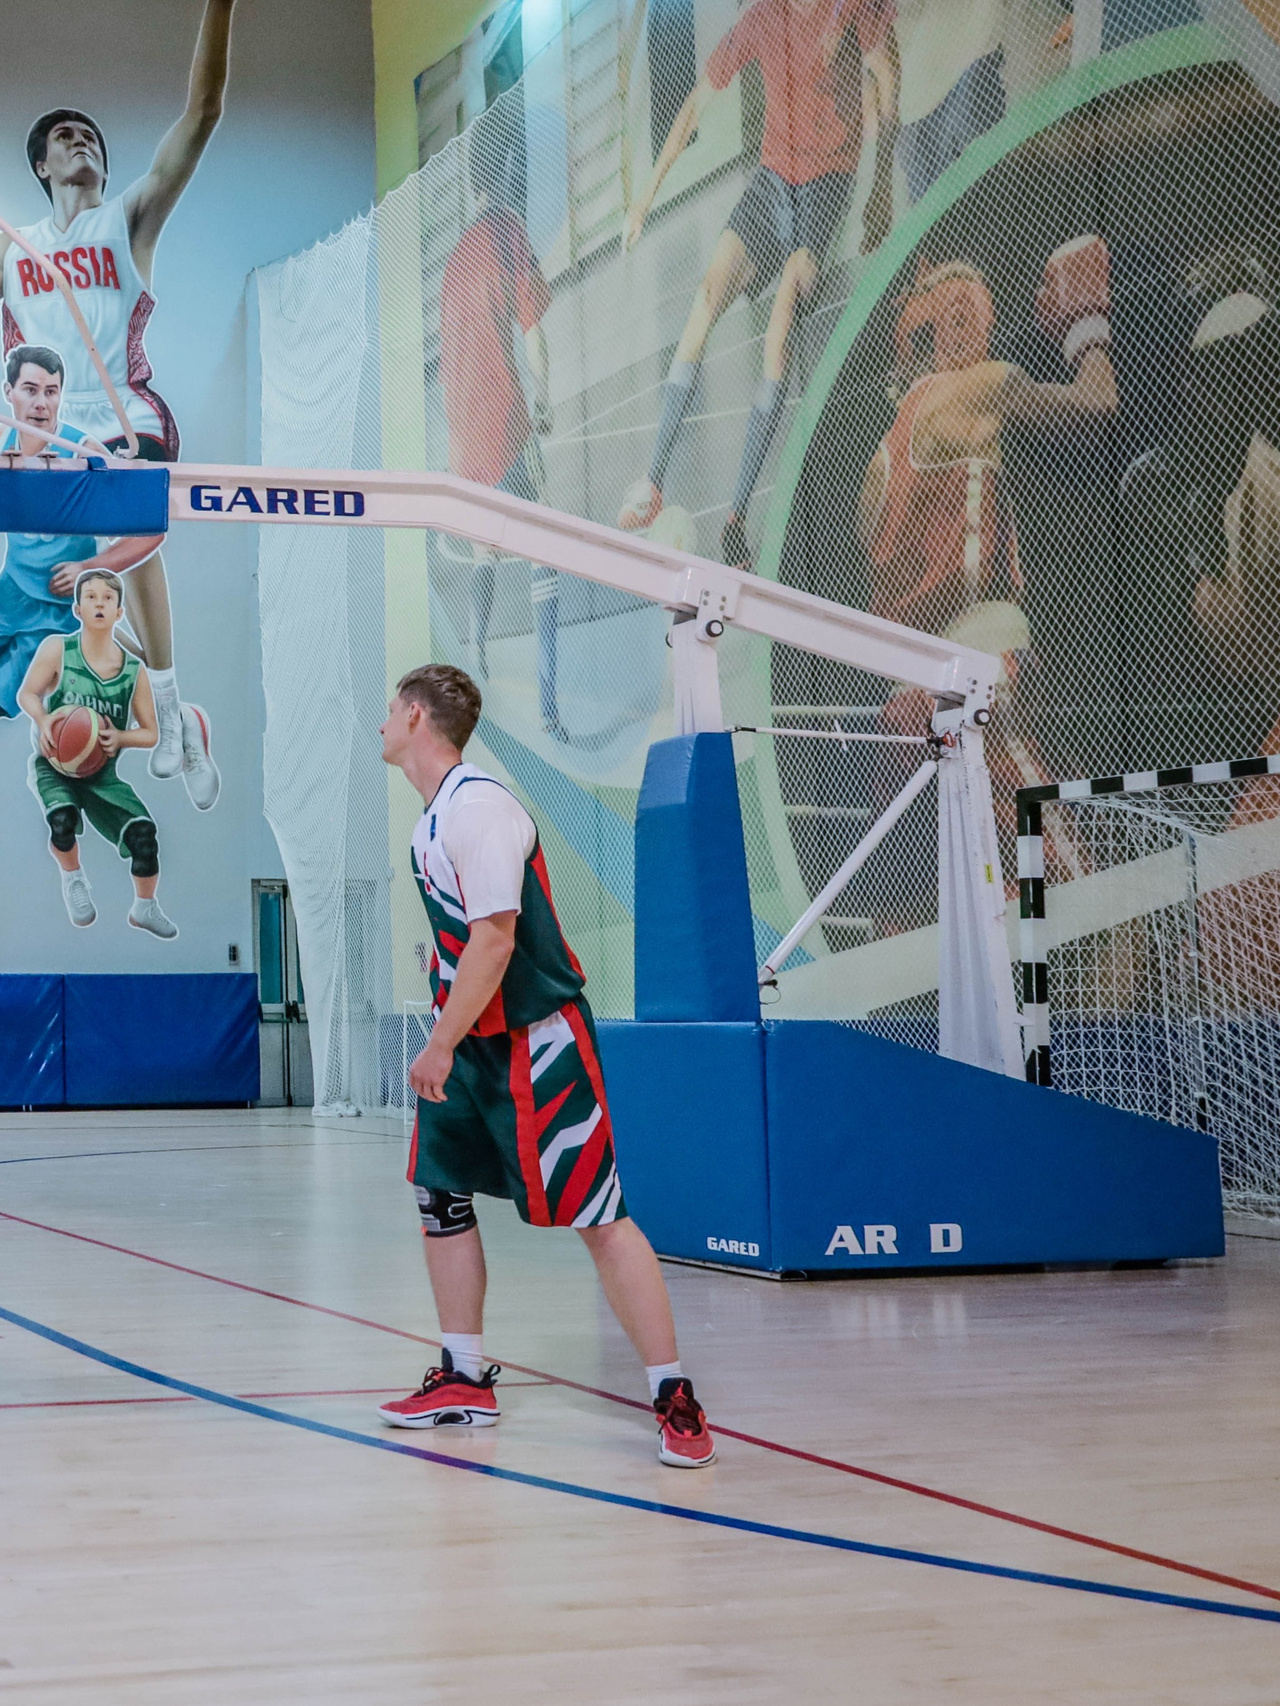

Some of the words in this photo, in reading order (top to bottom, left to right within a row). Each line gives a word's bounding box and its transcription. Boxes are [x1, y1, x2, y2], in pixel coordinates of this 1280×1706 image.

[16, 246, 121, 297] RUSSIA
[190, 484, 365, 517] GARED
[706, 1236, 760, 1257] GARED
